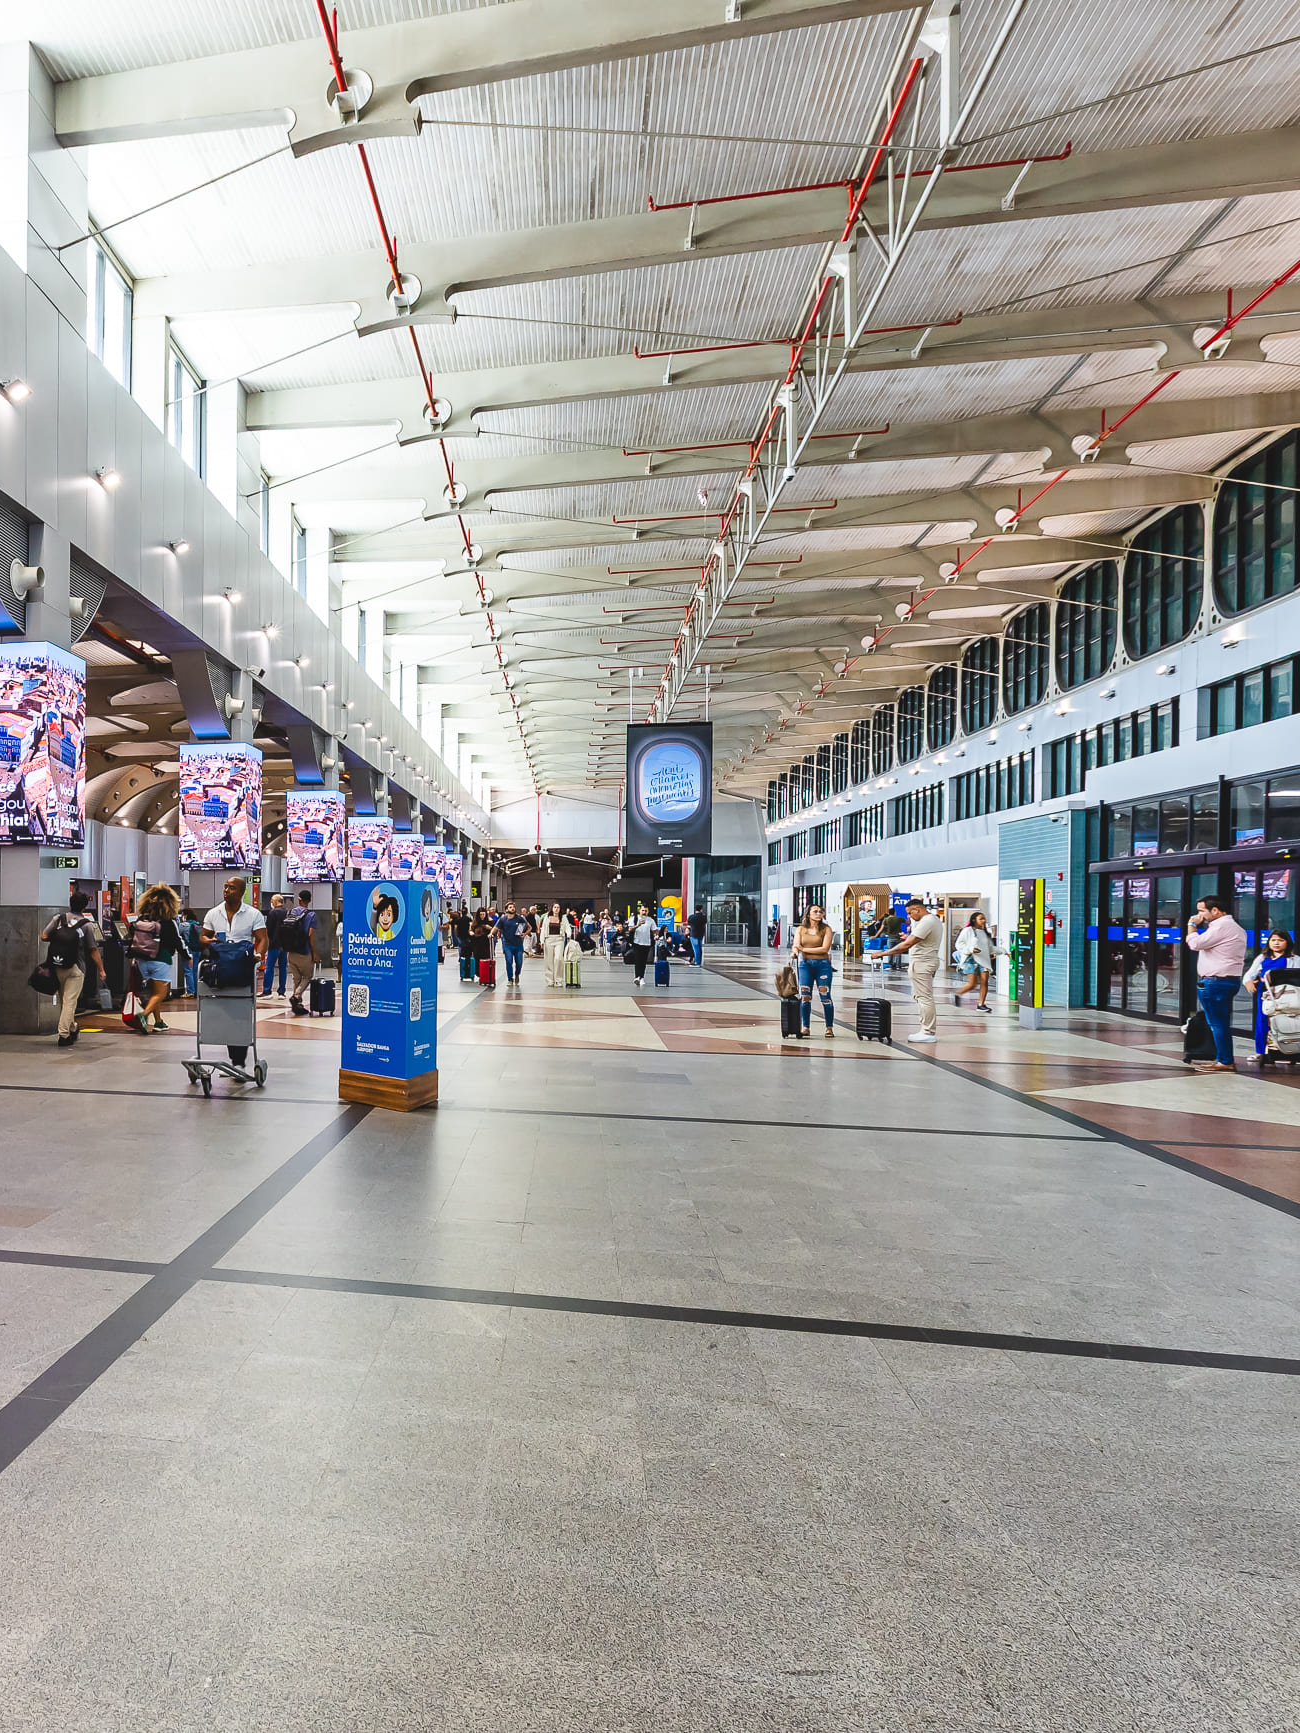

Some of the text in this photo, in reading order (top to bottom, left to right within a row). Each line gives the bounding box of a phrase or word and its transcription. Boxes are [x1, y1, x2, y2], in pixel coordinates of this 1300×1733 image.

[348, 931, 386, 945] Dúvidas?
[348, 944, 398, 957] Pode contar
[347, 957, 394, 968] com a Ana.
